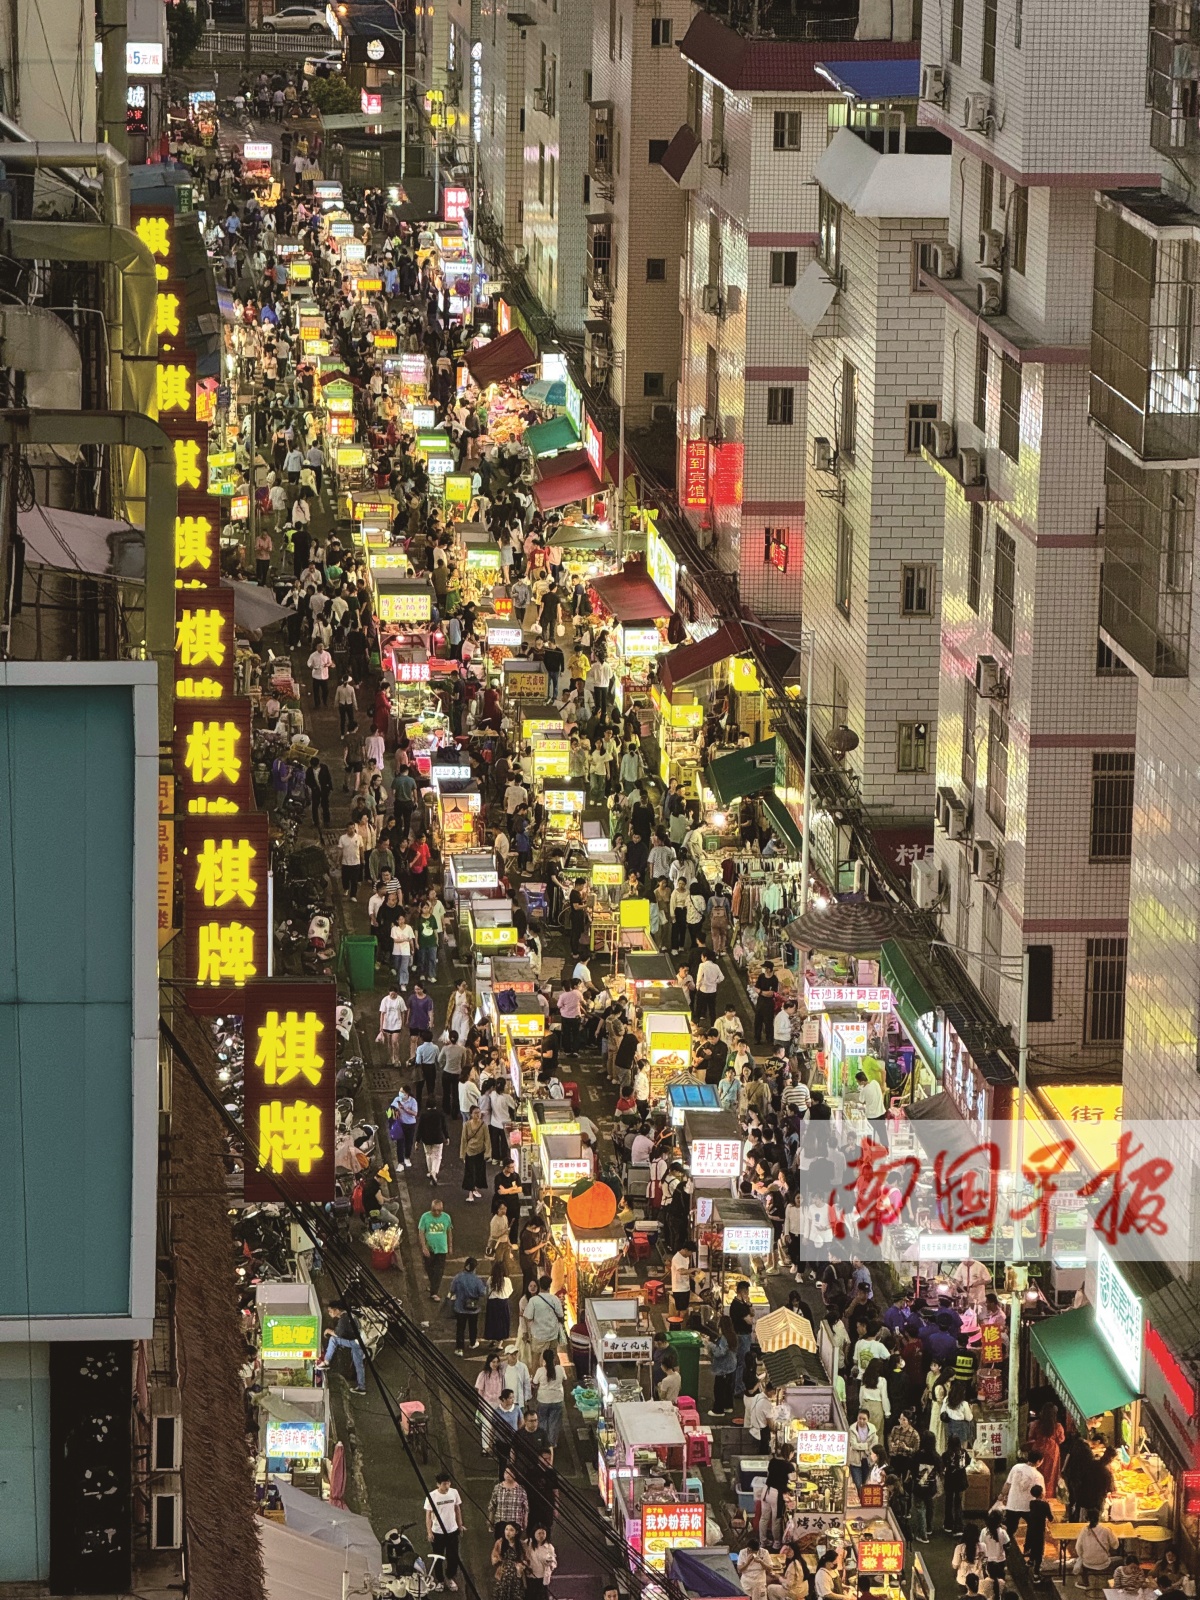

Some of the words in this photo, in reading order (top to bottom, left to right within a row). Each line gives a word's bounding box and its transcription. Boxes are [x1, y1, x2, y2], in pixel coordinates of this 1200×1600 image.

[688, 443, 707, 497] 福到宾馆
[519, 675, 545, 686] 广式卤味
[538, 741, 568, 751] 烤冷面
[185, 721, 241, 814] 棋
[195, 839, 258, 987] 棋牌
[810, 988, 890, 1000] 长沙汤汁臭豆腐
[255, 1011, 325, 1174] 棋牌
[697, 1143, 740, 1161] 薄片臭豆腐
[726, 1229, 769, 1239] 石磨玉米饼
[582, 1245, 603, 1253] 100%
[982, 1326, 1001, 1362] 修鞋
[799, 1433, 846, 1443] 特色烤冷面
[646, 1514, 702, 1530] 我炒粉养你
[797, 1517, 842, 1529] 烤冷面
[861, 1543, 902, 1557] 王炸鸭爪
